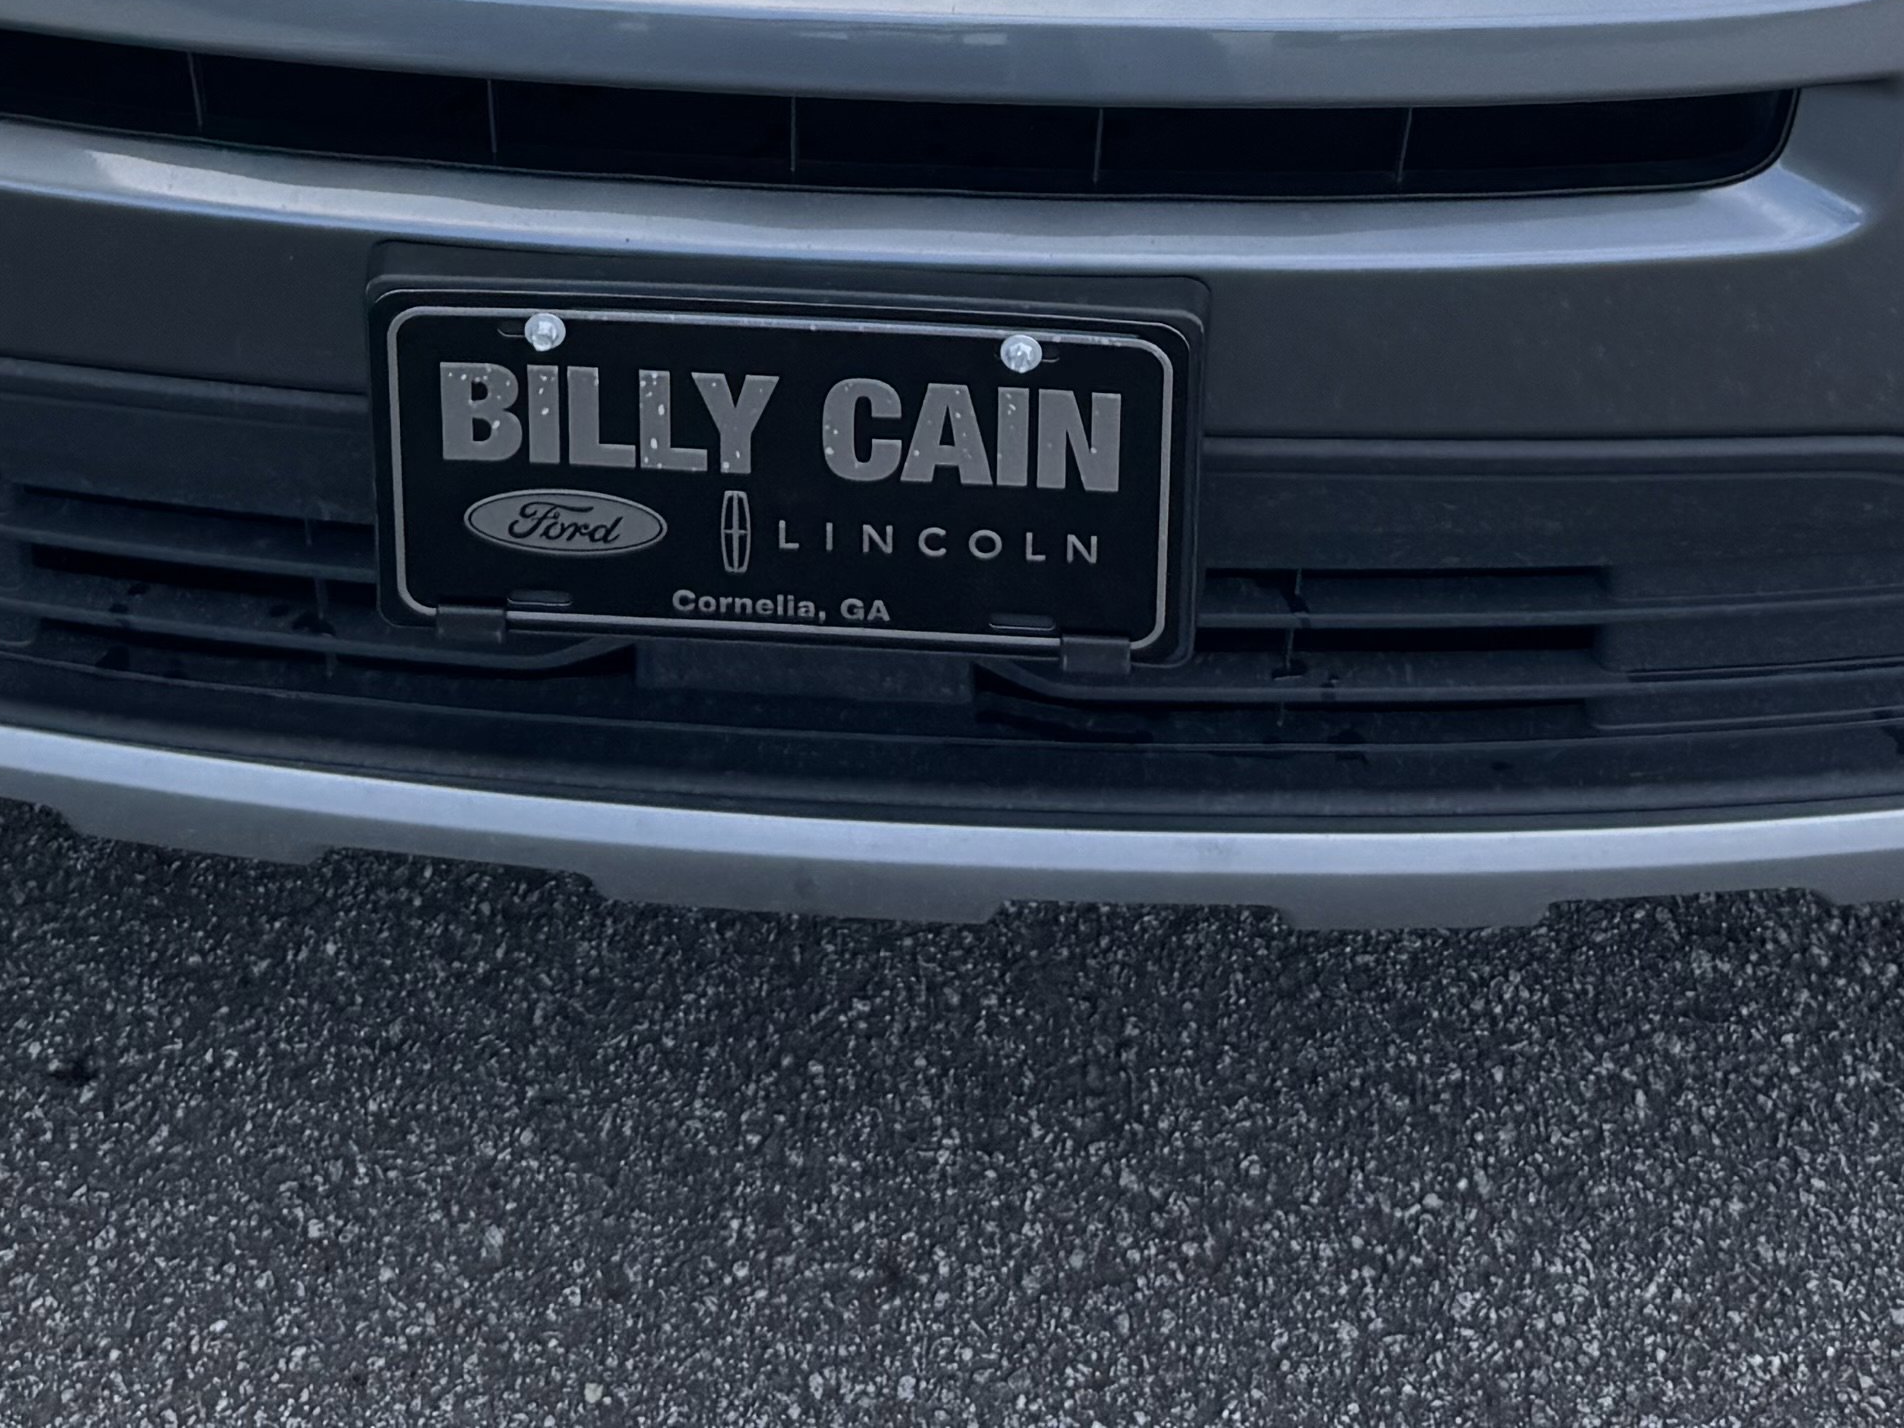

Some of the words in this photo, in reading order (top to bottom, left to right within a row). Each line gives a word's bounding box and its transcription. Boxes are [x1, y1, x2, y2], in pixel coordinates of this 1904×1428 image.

[438, 361, 779, 474] BILLY
[822, 378, 1122, 492] CAIN
[507, 499, 622, 546] Ford
[778, 519, 1099, 564] LINCOLN
[672, 589, 826, 624] Cornelia,
[840, 599, 891, 624] GA
